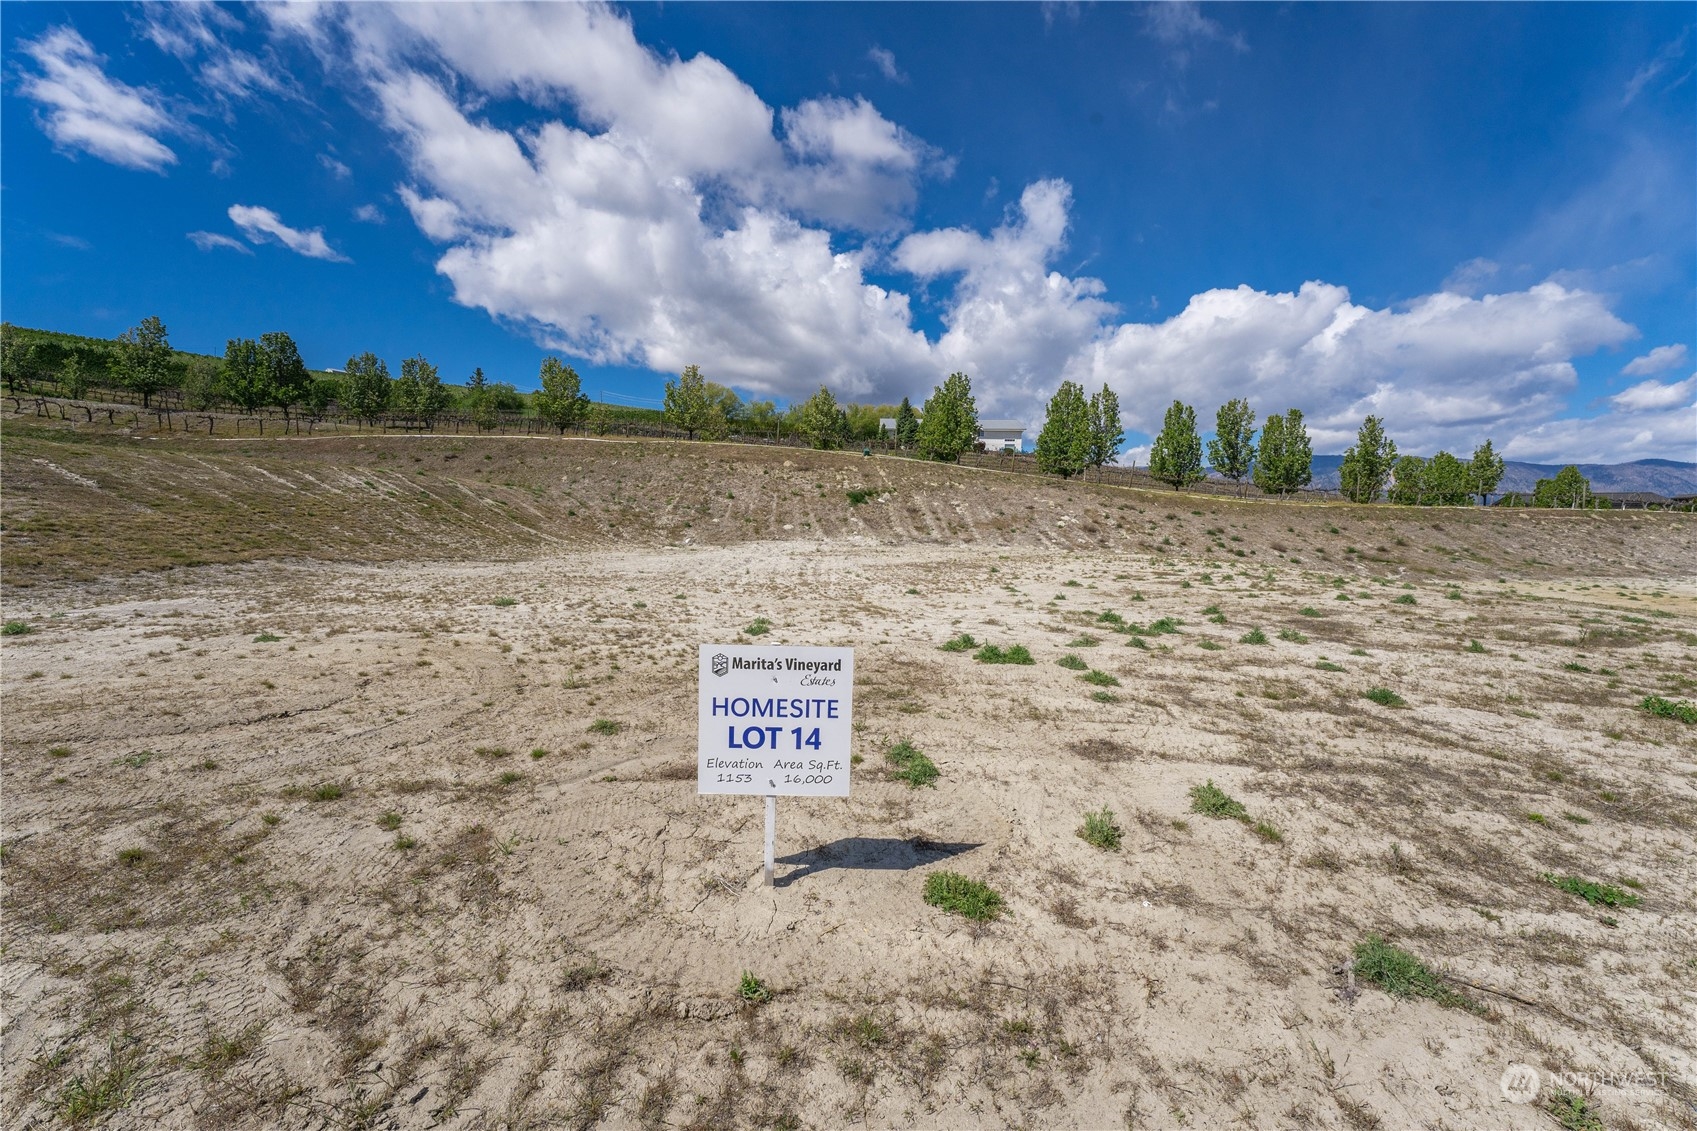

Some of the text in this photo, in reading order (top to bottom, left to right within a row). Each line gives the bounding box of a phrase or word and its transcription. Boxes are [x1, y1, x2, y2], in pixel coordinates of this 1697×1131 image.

[732, 657, 842, 674] Marita's Vineyard
[800, 674, 836, 687] Estates
[712, 697, 839, 719] HOMESITE
[728, 726, 822, 750] LOT 14
[706, 757, 843, 773] Elevation Area Sq.Ft.
[717, 773, 833, 785] 1153 16,000
